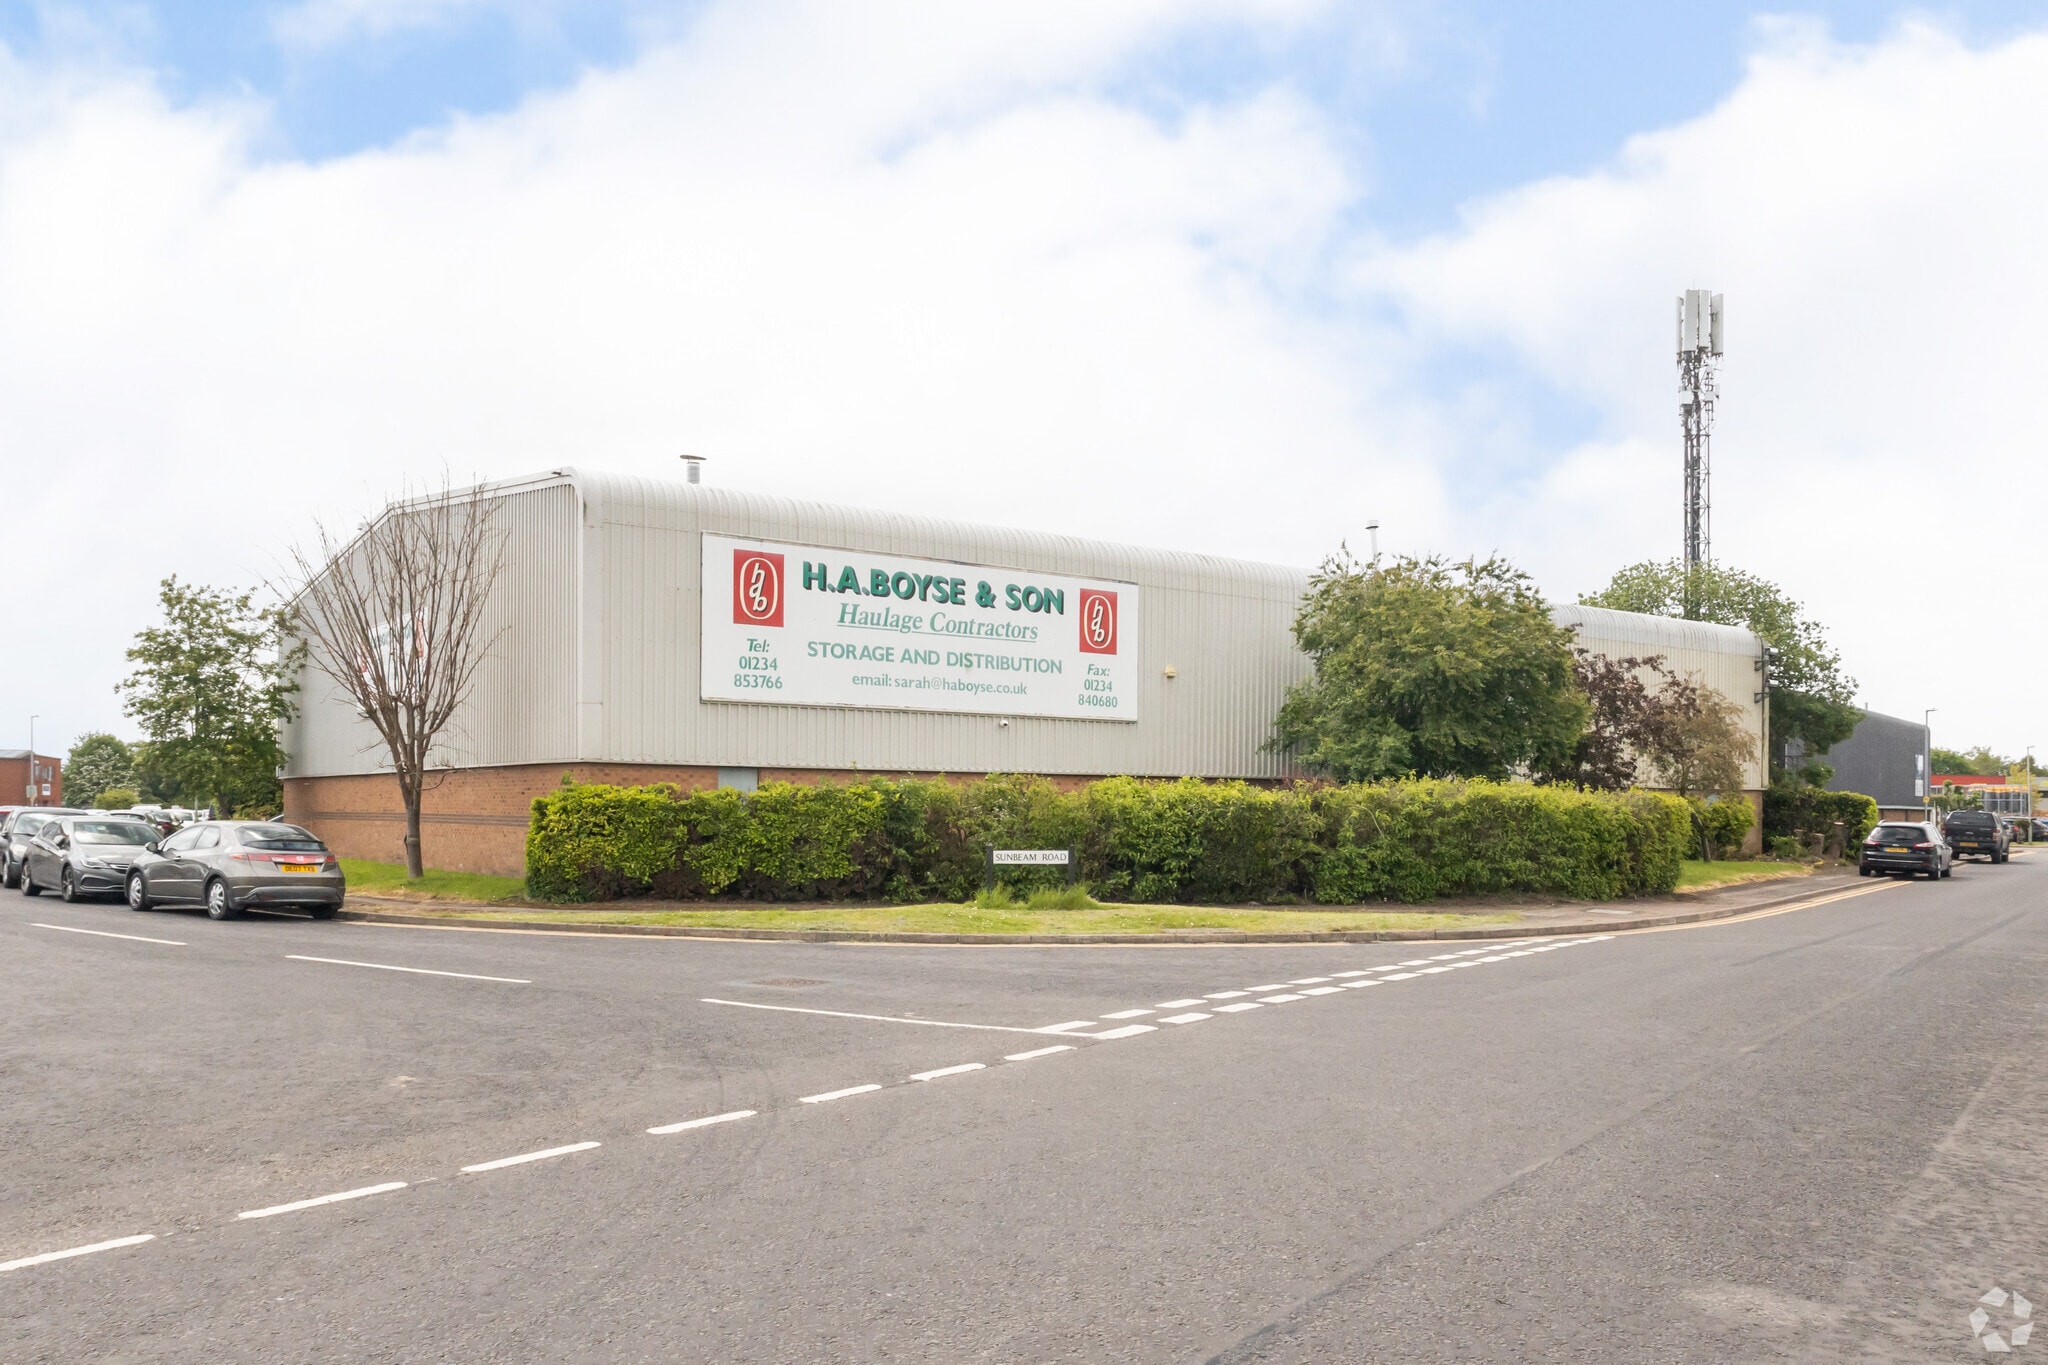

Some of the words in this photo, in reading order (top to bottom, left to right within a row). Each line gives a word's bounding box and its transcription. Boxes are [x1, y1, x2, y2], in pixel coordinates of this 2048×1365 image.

[803, 560, 966, 605] H.A.BOYSE
[974, 580, 996, 608] &
[1005, 583, 1064, 615] SON
[837, 602, 923, 633] Haulage
[929, 611, 1038, 640] Contractors
[747, 638, 770, 653] Tel:
[738, 656, 778, 671] 01234
[807, 641, 895, 662] STORAGE
[900, 648, 940, 666] AND
[946, 651, 1062, 674] DISTRIBUTION
[1087, 663, 1110, 677] Fax:
[733, 674, 783, 689] 853766
[852, 673, 892, 687] email:
[894, 675, 1027, 695] sarah@haboyse.co.uk
[1084, 678, 1113, 692] 01234
[1078, 693, 1118, 708] 840680
[995, 853, 1037, 862] SUNBEAM
[1042, 853, 1067, 862] ROAD
